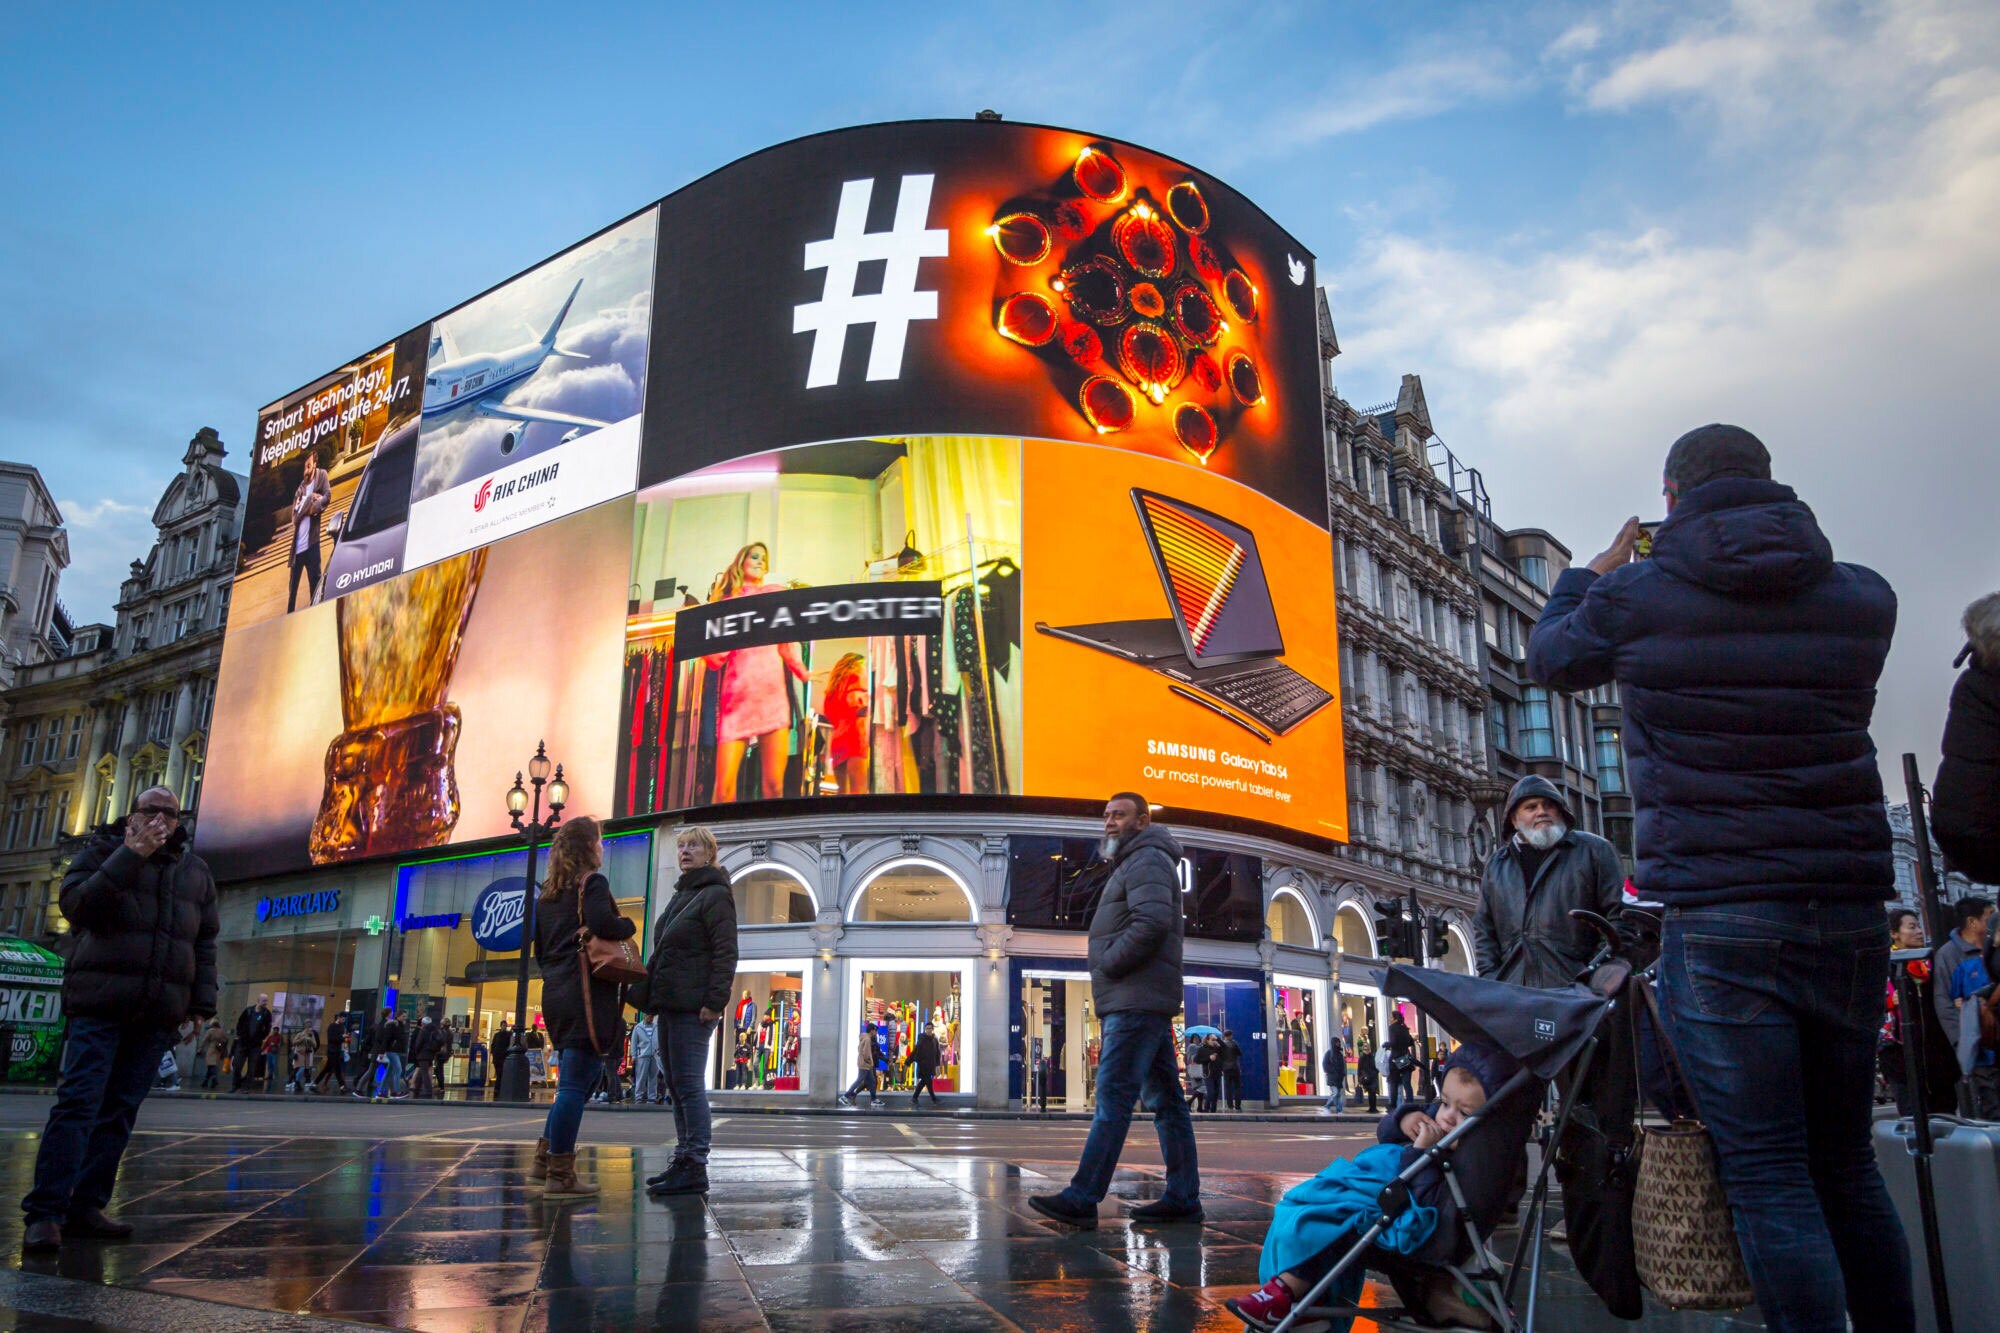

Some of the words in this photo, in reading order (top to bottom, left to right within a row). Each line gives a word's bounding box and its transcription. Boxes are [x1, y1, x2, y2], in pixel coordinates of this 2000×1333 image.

[264, 404, 305, 439] Smart
[307, 366, 386, 419] Technology,
[260, 426, 312, 465] keeping
[313, 415, 338, 444] you
[340, 399, 371, 426] safe
[372, 375, 411, 412] 24/7.
[493, 480, 516, 502] AIR
[518, 462, 560, 493] CHINA
[353, 558, 394, 582] HYUNDAI
[1147, 739, 1216, 763] SAMSUNG
[1220, 751, 1260, 775] Galaxy
[1260, 760, 1277, 775] Tab
[1277, 764, 1289, 780] S4
[1143, 765, 1166, 780] Our
[1169, 768, 1200, 784] most
[1201, 774, 1248, 792] powerful
[1249, 782, 1274, 798] tablet
[1275, 790, 1292, 803] ever
[271, 888, 341, 918] BARCLAYS
[476, 889, 526, 938] Boot
[400, 912, 462, 934] pharmacy
[0, 950, 47, 963] ICKED
[8, 965, 33, 974] SHOW
[34, 967, 43, 975] IN
[46, 968, 65, 976] TOW
[1538, 1022, 1552, 1032] ZY
[11, 1039, 31, 1052] 100
